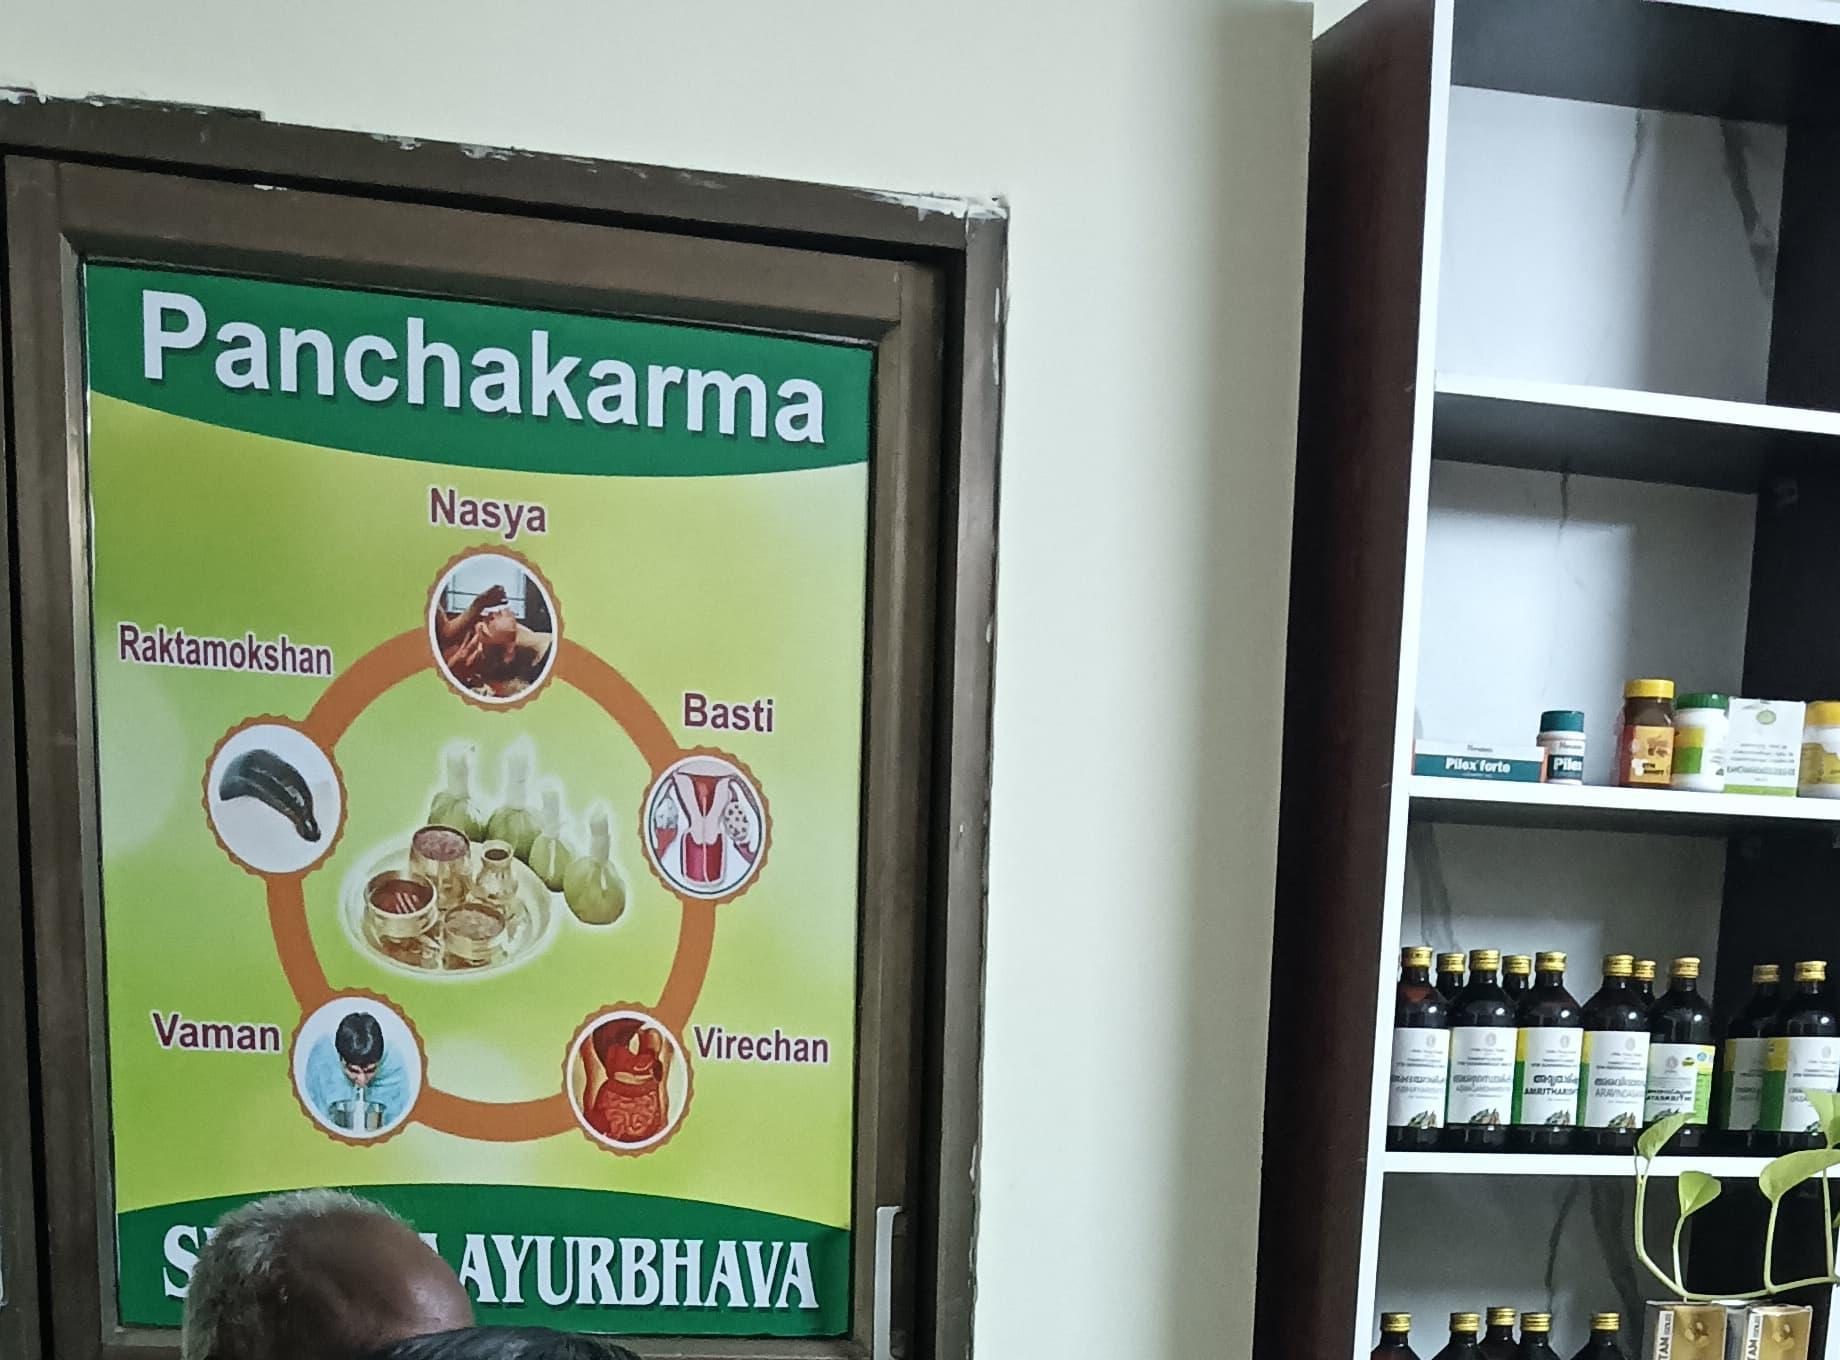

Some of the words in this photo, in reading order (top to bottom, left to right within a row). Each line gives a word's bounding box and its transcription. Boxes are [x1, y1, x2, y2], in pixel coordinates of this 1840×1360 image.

[141, 289, 826, 443] Panchakarma
[430, 488, 547, 538] Nasya
[119, 624, 332, 676] Raktamokshan
[683, 692, 774, 733] Basti
[1445, 757, 1478, 771] Pilex
[1479, 759, 1511, 773] forte
[152, 1013, 280, 1052] Vaman
[694, 1027, 829, 1065] Virechan
[458, 1236, 818, 1309] AYURBHAVA
